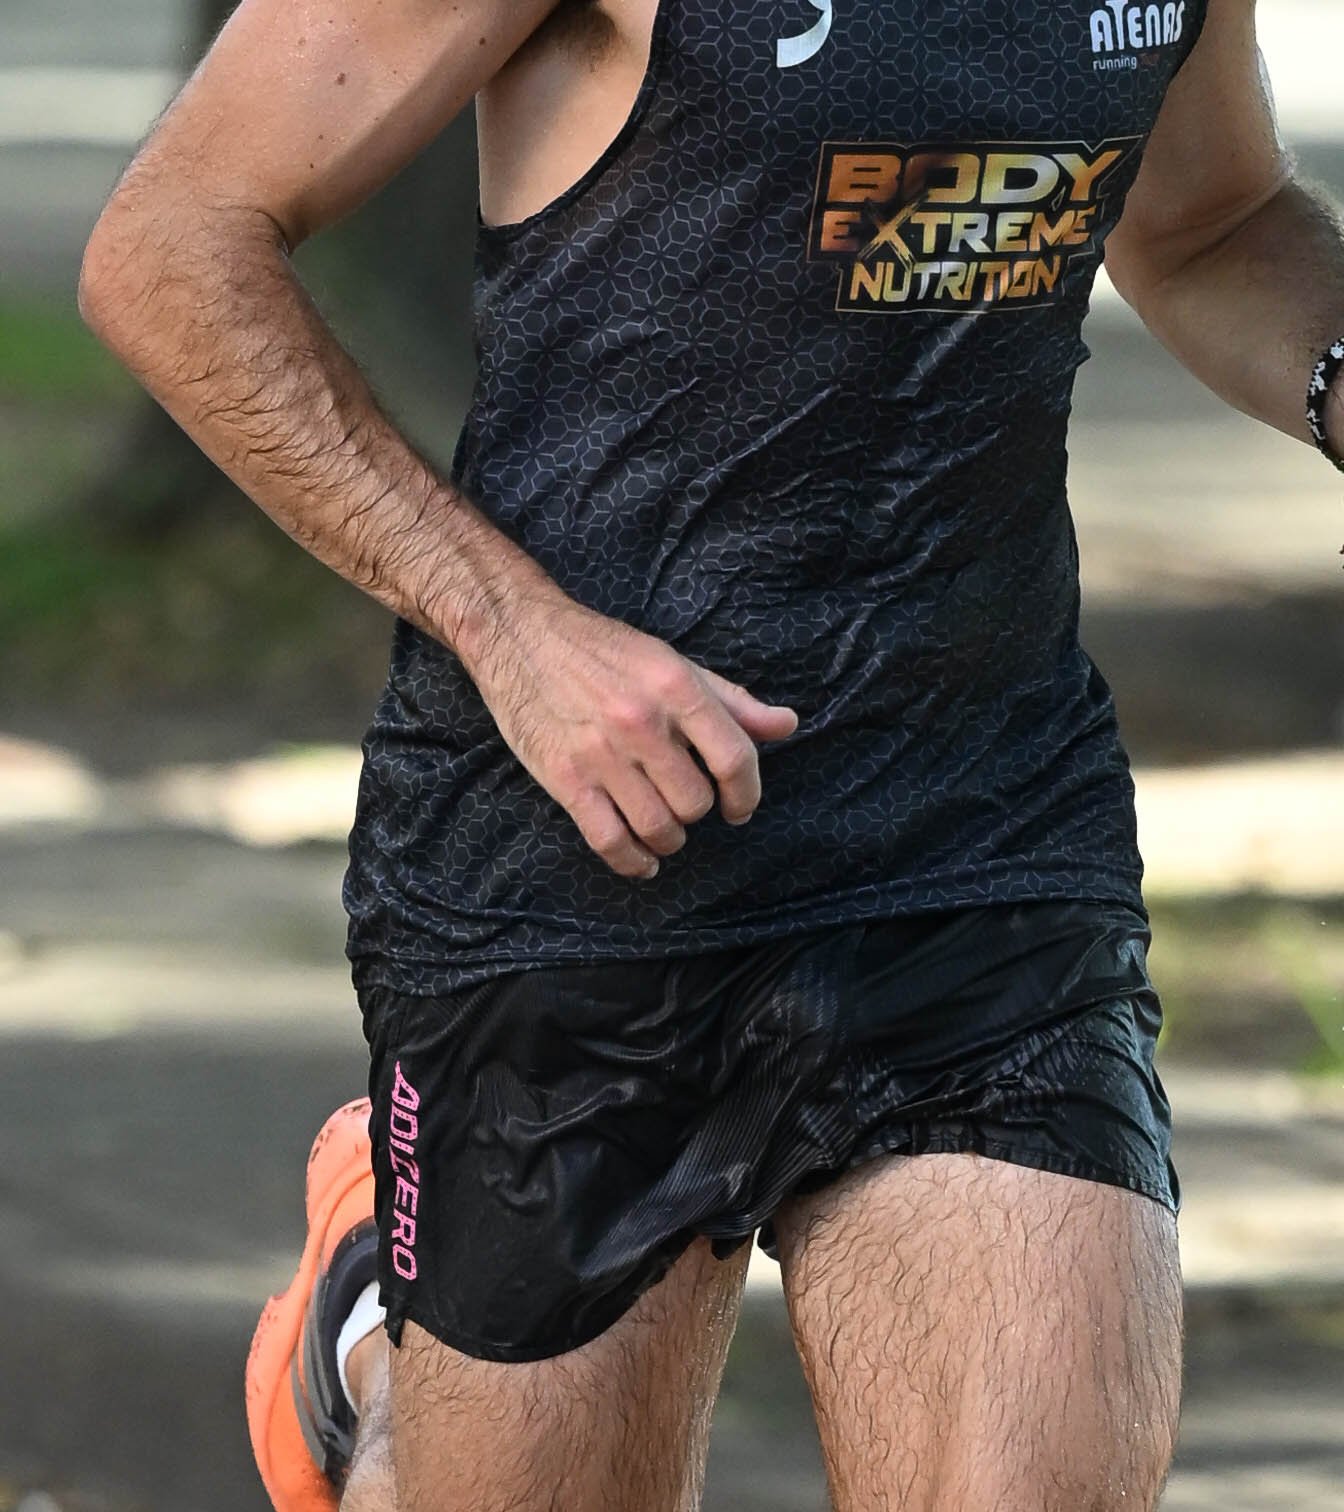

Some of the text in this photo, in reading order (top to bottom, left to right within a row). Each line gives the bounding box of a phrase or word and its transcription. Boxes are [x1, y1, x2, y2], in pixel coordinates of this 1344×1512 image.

[1093, 54, 1137, 71] running
[826, 152, 1122, 204] BODY
[820, 196, 1096, 267] EXTREME
[849, 257, 1061, 302] NUTRITION
